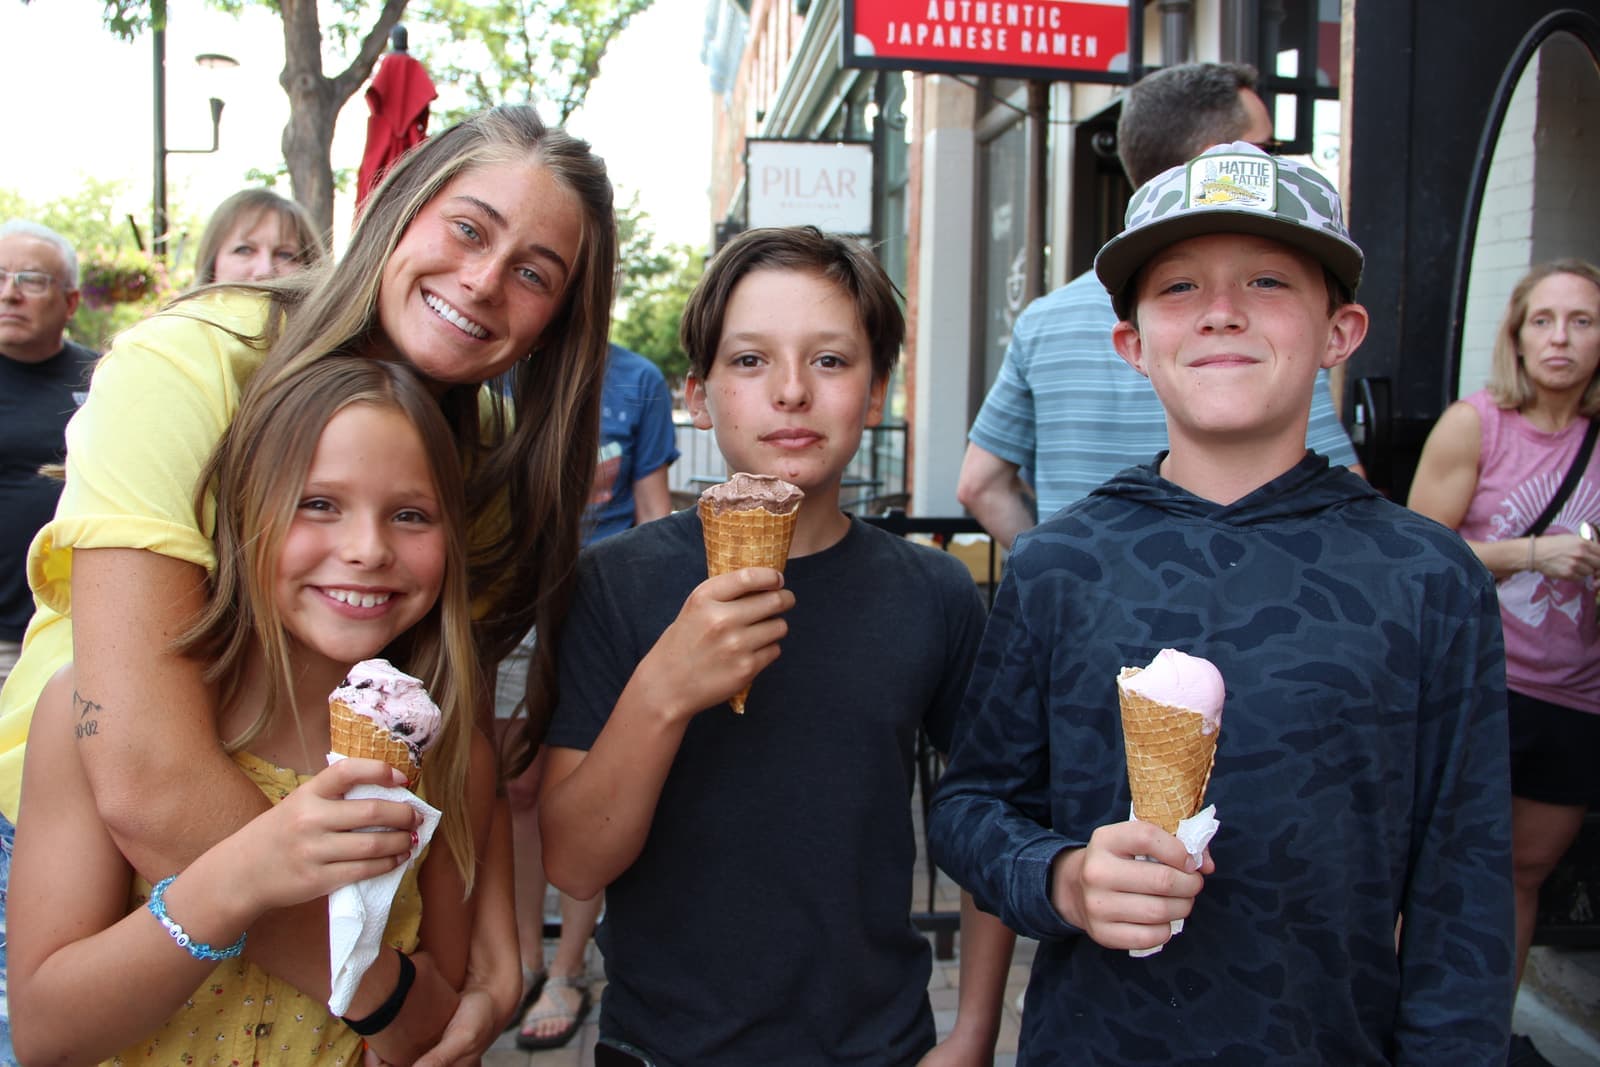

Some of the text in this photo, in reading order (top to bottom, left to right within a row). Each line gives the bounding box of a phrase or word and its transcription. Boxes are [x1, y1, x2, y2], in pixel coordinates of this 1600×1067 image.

[926, 0, 1061, 29] AUTHENTIC
[886, 21, 1097, 58] JAPANESE RAMEN
[762, 165, 857, 199] PILAR
[1219, 161, 1270, 176] HATTIE
[1232, 174, 1270, 188] FATTIE
